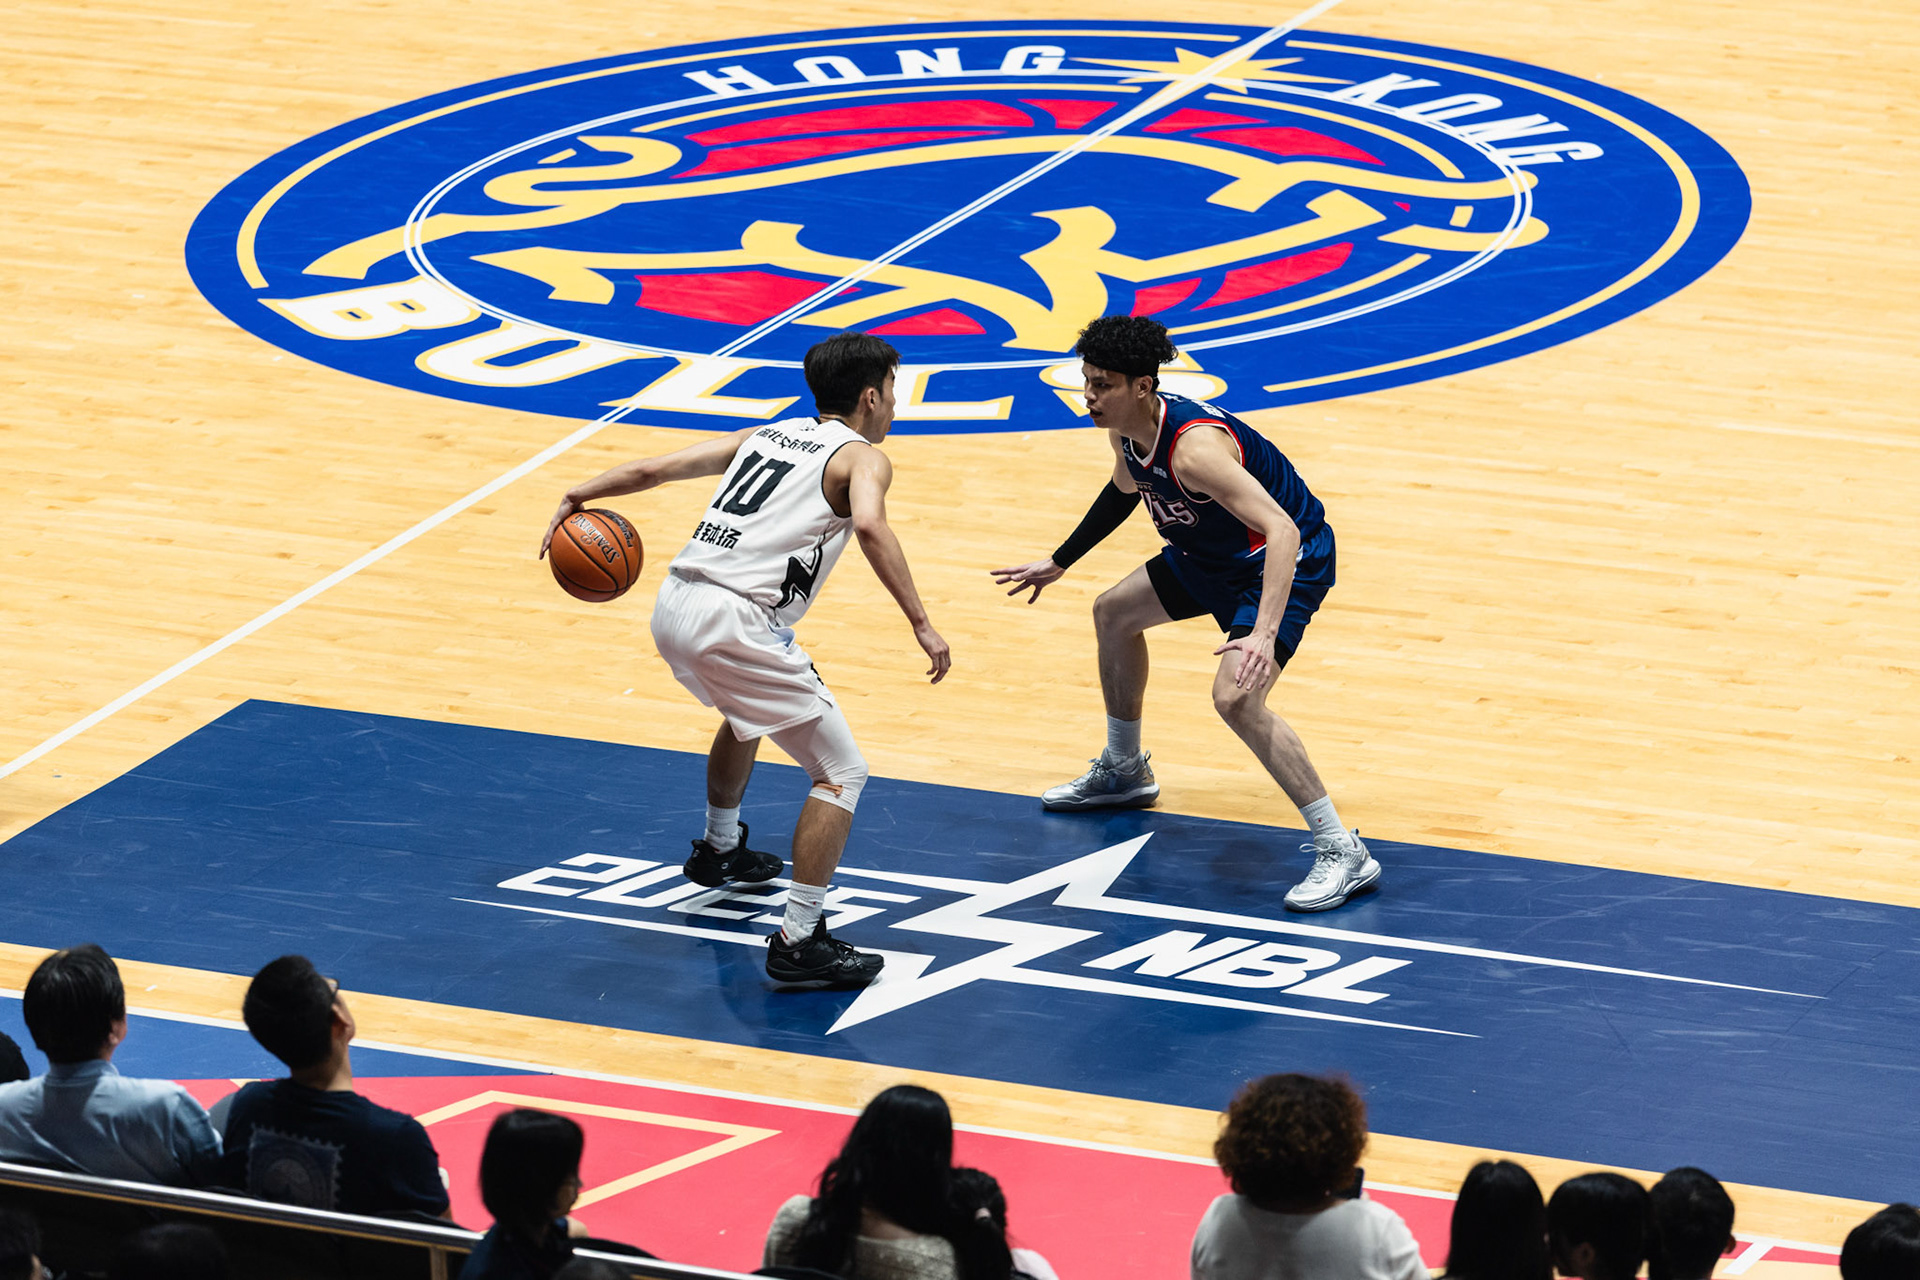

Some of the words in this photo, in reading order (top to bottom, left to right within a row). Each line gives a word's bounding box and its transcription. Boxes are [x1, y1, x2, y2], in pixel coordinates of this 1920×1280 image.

[683, 45, 1066, 98] HONG
[1326, 72, 1604, 168] KONG
[711, 450, 796, 517] 10
[570, 513, 621, 564] SPALDING
[1081, 930, 1414, 1005] NBL
